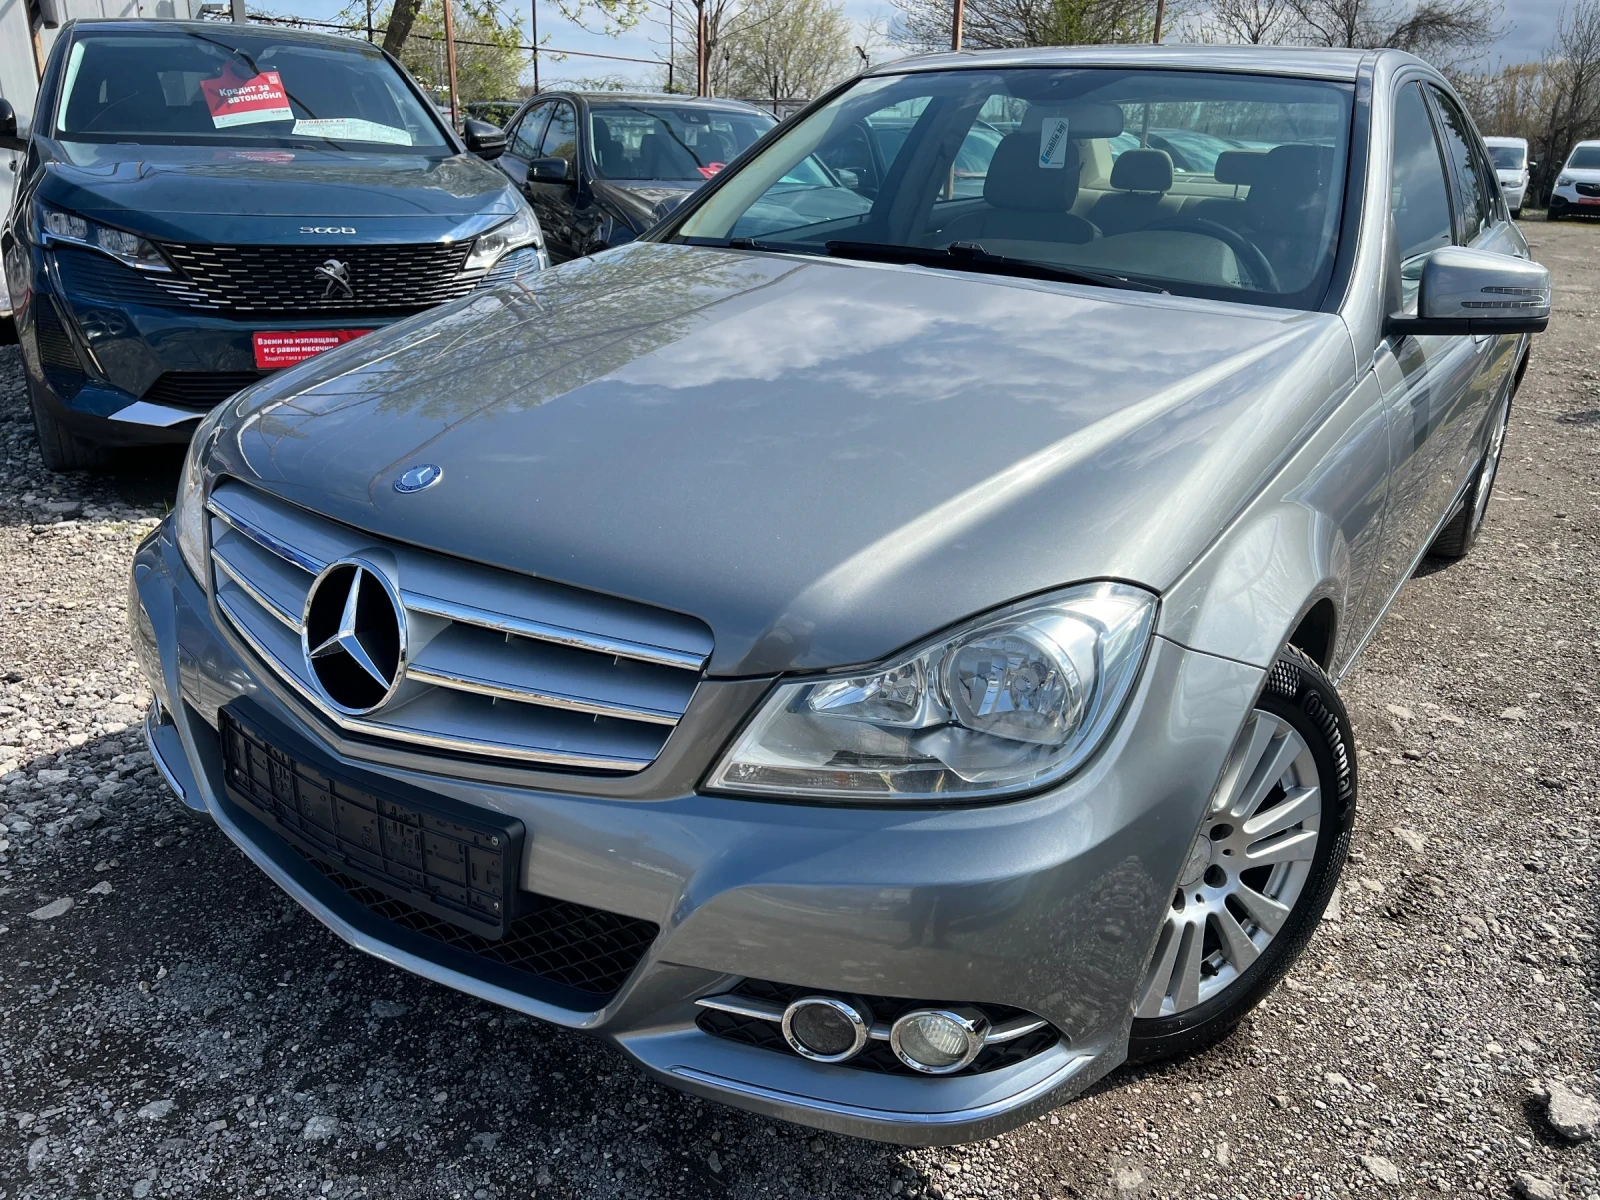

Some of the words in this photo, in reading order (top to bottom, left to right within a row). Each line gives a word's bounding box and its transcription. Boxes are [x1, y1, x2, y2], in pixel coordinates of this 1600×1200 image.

[219, 85, 256, 97] Кредит
[228, 91, 282, 104] автомобил
[299, 226, 357, 234] 3008
[276, 346, 301, 354] равни
[1304, 689, 1353, 802] Continental
